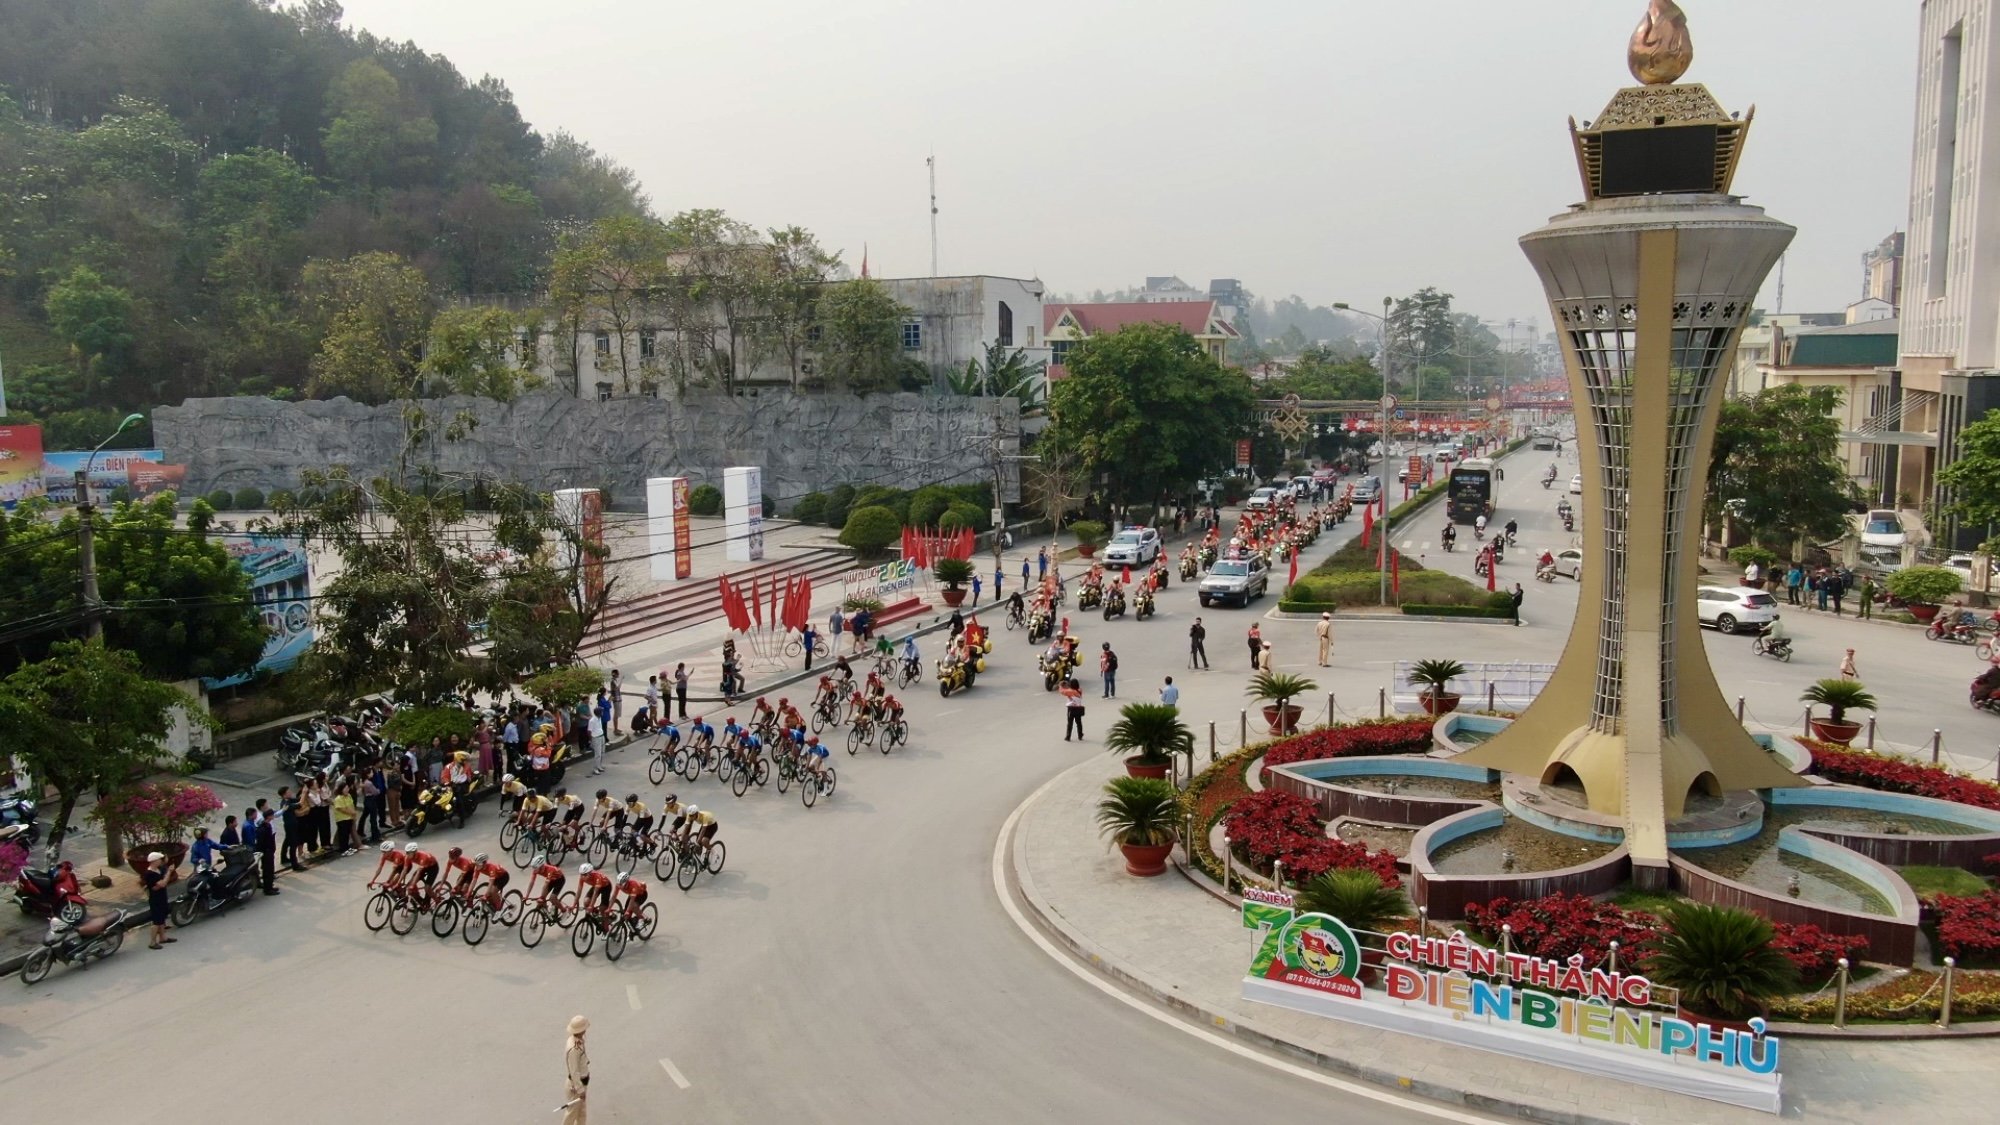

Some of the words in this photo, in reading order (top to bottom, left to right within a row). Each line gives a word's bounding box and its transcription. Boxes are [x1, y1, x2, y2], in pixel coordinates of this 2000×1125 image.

[879, 556, 915, 583] 2024
[1242, 899, 1361, 990] 70
[1386, 929, 1497, 977] CHIẾN
[1504, 952, 1650, 1006] THẮNG
[1384, 962, 1513, 1022] ĐIỆN
[1521, 988, 1652, 1050] BIÊN
[1660, 1016, 1779, 1074] PHỦ
